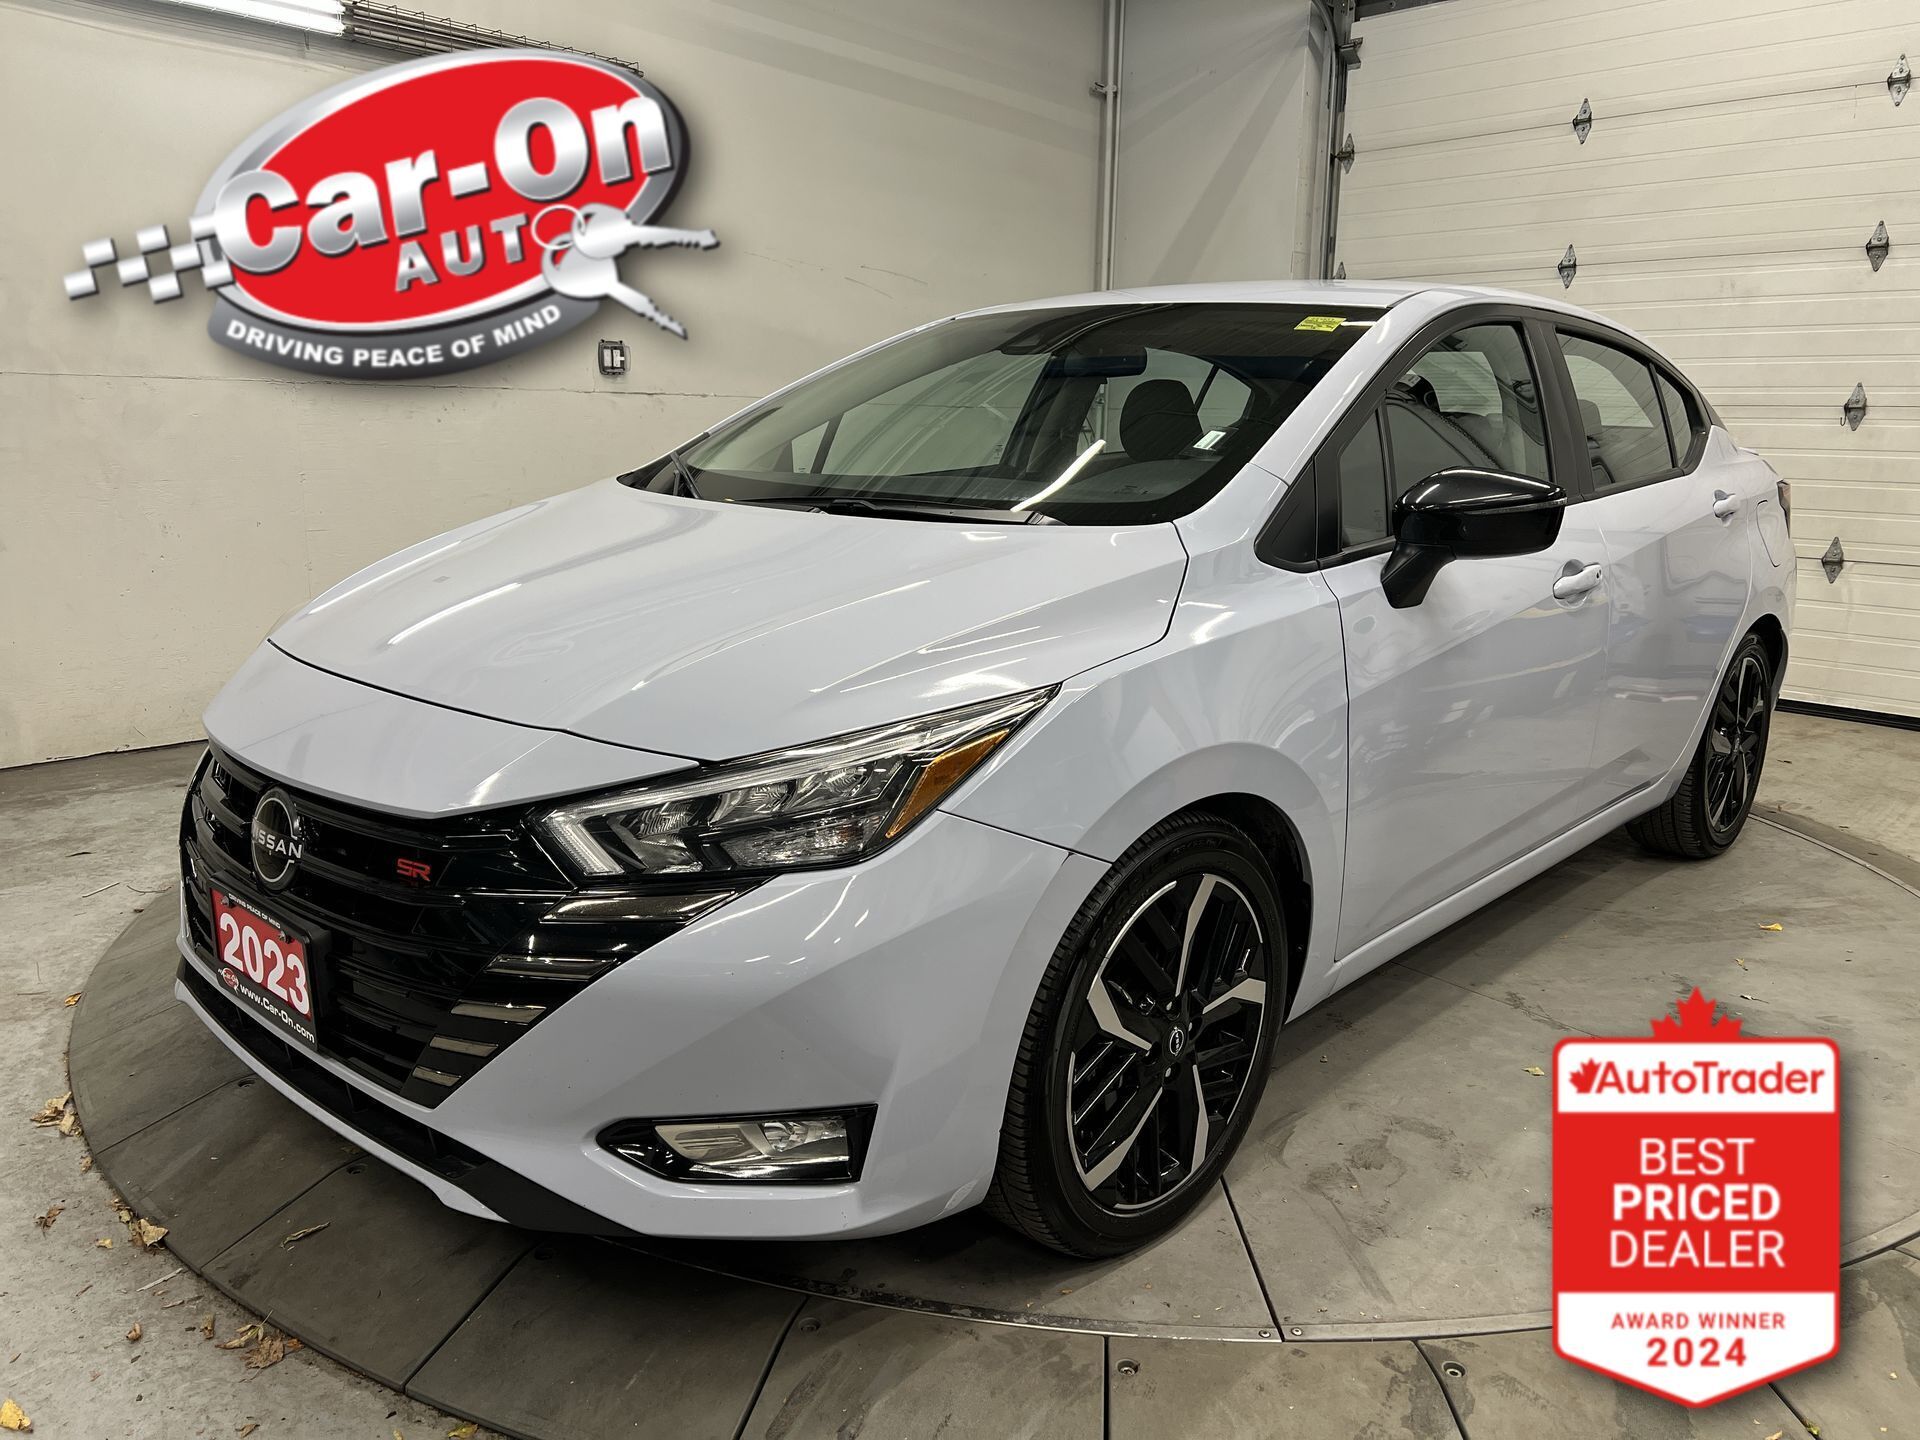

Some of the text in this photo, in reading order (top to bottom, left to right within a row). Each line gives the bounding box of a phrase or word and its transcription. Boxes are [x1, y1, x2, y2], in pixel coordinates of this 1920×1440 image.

[397, 858, 432, 882] SR
[219, 912, 311, 1016] 2023
[240, 984, 315, 1043] www.Car-On.com
